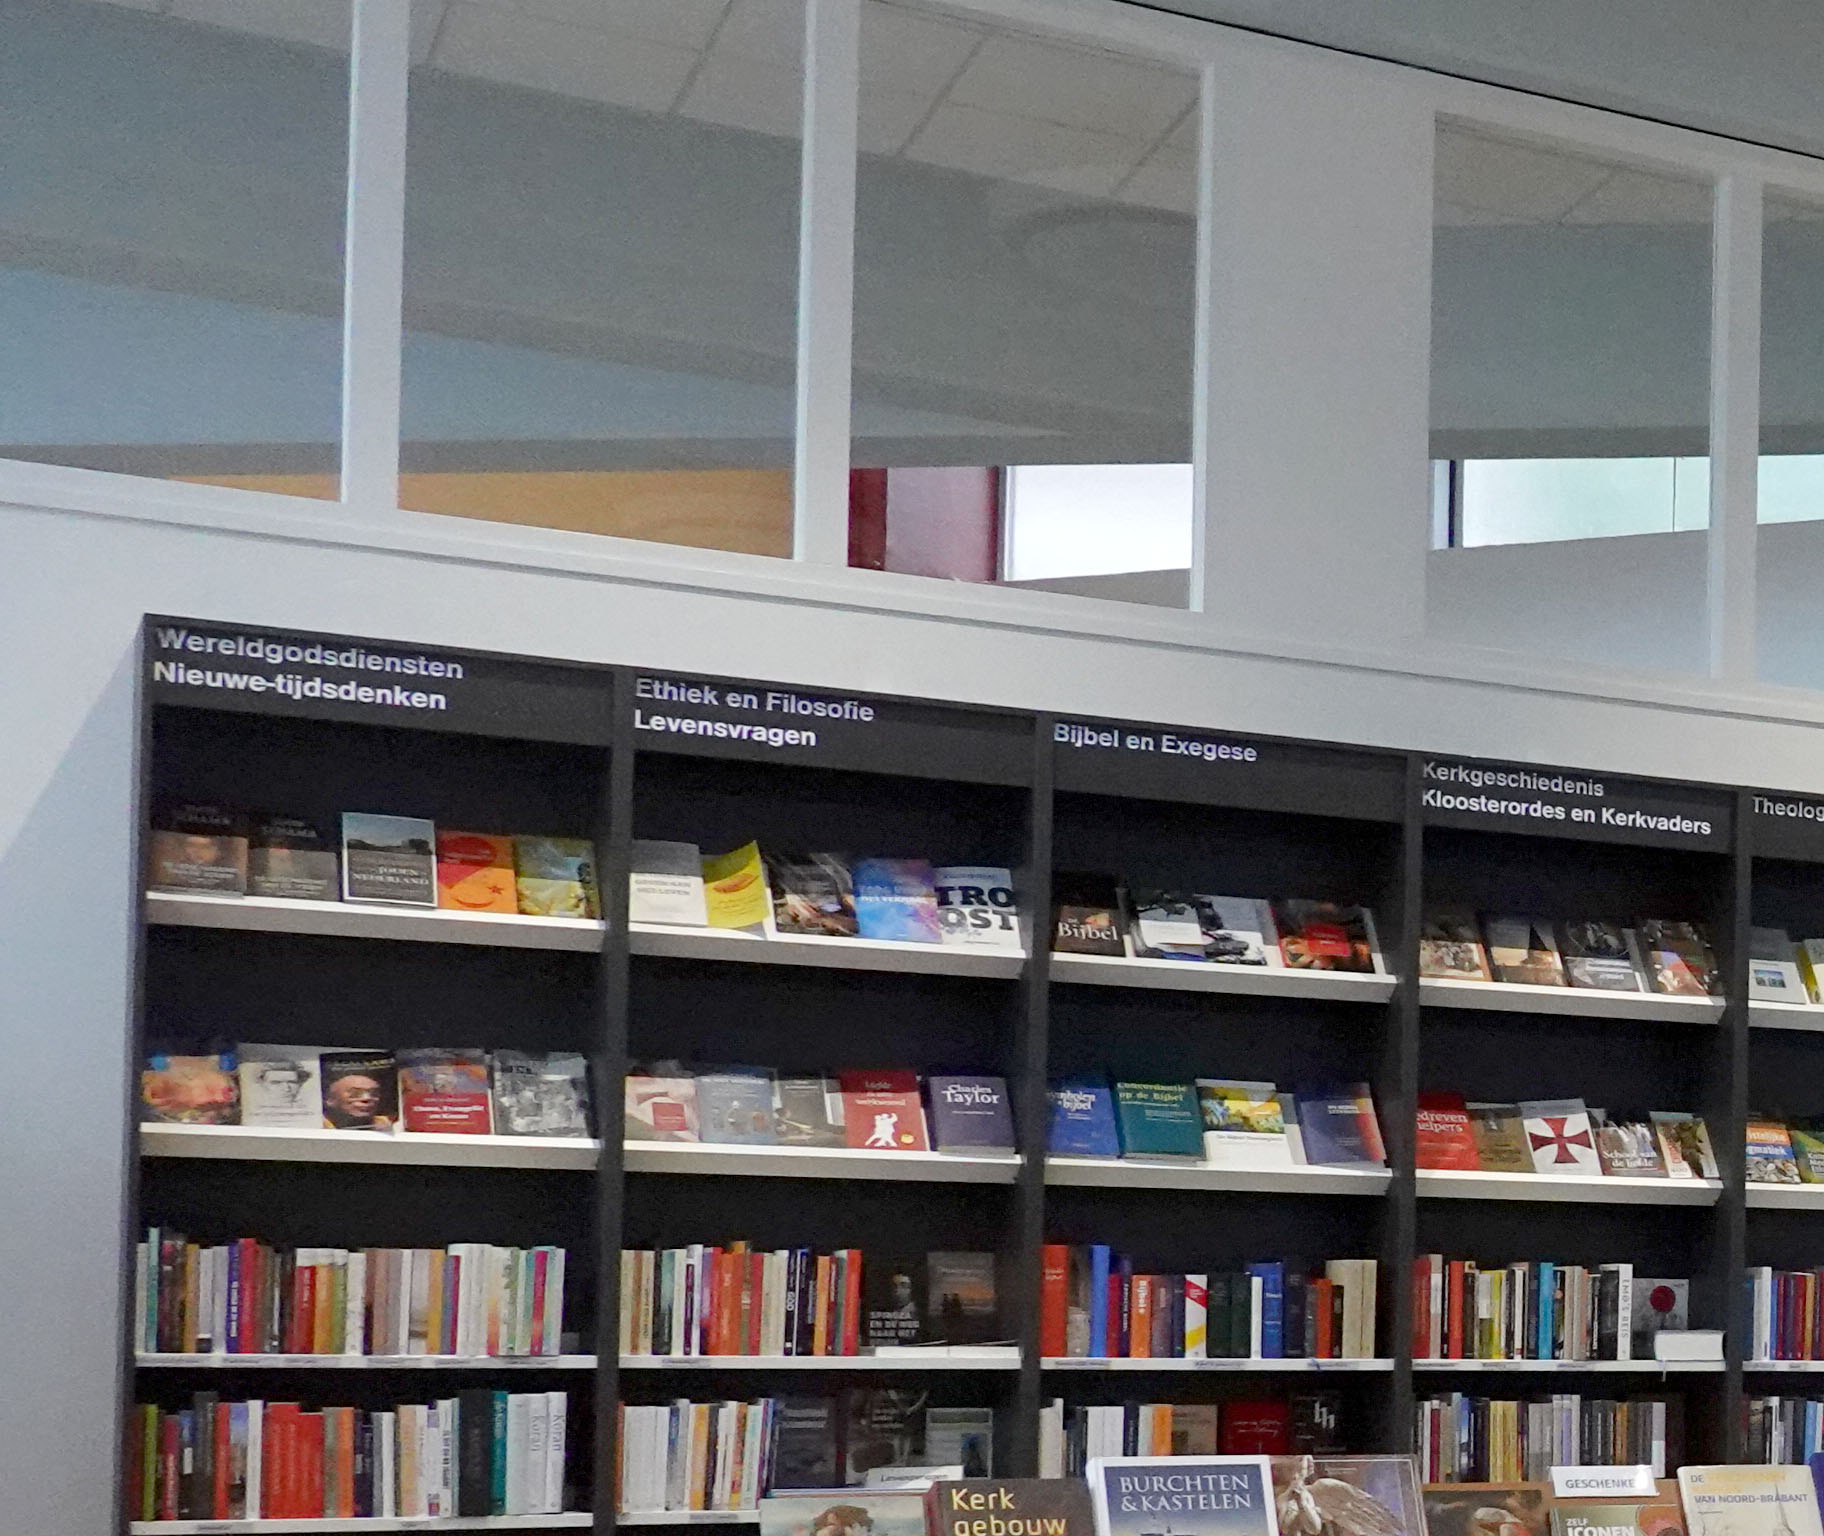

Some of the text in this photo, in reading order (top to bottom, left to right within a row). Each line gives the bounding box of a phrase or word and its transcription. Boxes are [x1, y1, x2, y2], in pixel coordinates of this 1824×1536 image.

[156, 627, 464, 679] Wereldgodsdiensten
[154, 661, 447, 710] Nieuwe-tijdsdenken
[635, 677, 875, 722] Ethiek en Filosofie
[634, 709, 817, 747] Levensvragen
[1054, 723, 1258, 761] Bijbel en Exegese
[1422, 761, 1604, 796] Kerkgeschiedenis
[1421, 790, 1712, 835] Kloosterordes en Kerkvaders
[1058, 921, 1119, 941] Bijbel
[942, 1090, 1001, 1106] Taylor
[946, 1084, 991, 1094] Charles
[1119, 1474, 1250, 1493] BURCHTEN
[1690, 1474, 1705, 1484] DE
[951, 1487, 1016, 1511] Kerk
[1120, 1493, 1251, 1512] & KASTELEN
[1694, 1493, 1809, 1504] VAN NOORD-BRABANT
[1565, 1518, 1588, 1526] ZELF
